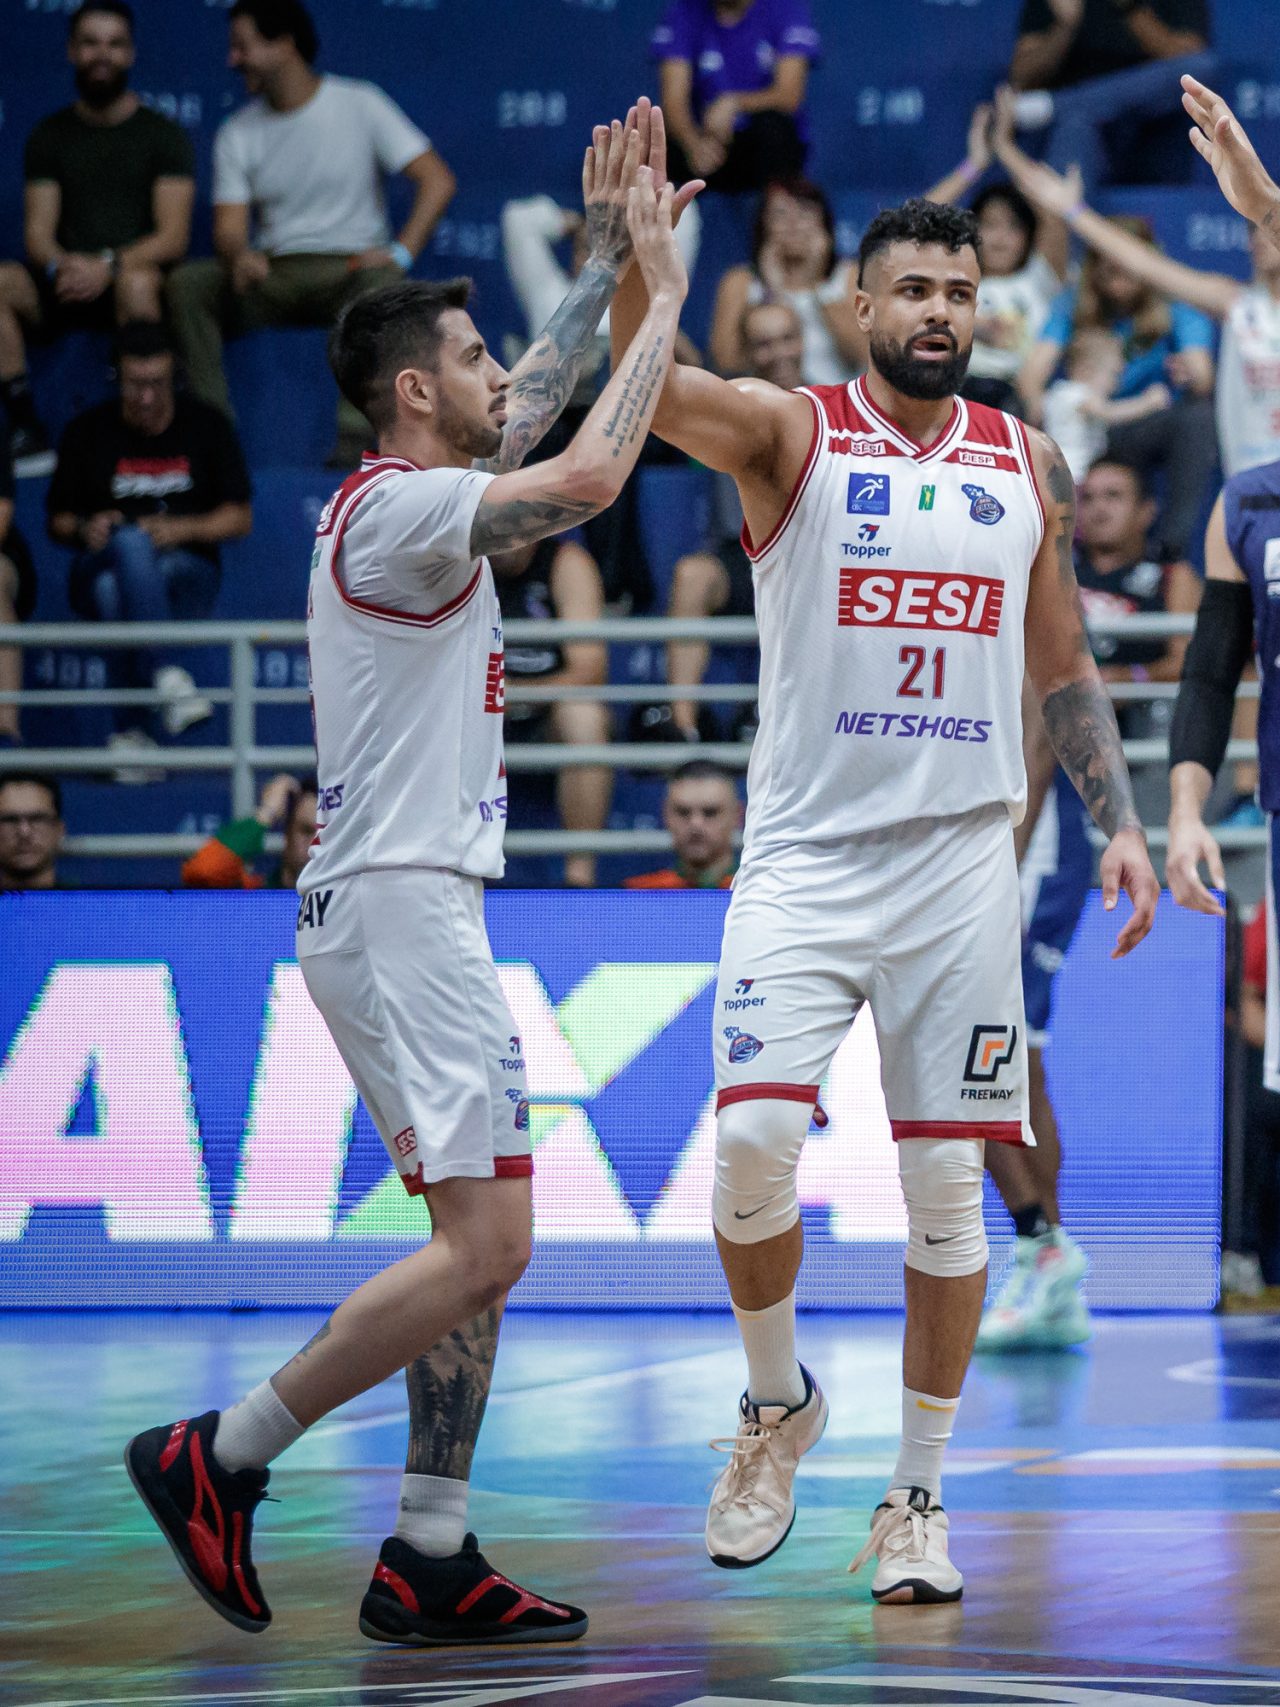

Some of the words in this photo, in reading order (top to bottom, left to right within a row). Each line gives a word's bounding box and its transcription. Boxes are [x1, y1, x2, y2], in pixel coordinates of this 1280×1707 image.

[852, 442, 882, 454] SESI
[962, 454, 993, 464] FIESP
[841, 543, 892, 559] Topper
[853, 576, 990, 629] SESI
[896, 644, 947, 700] 21
[835, 711, 993, 743] NETSHOES
[723, 996, 767, 1011] Topper
[960, 1088, 1014, 1100] FREEWAY
